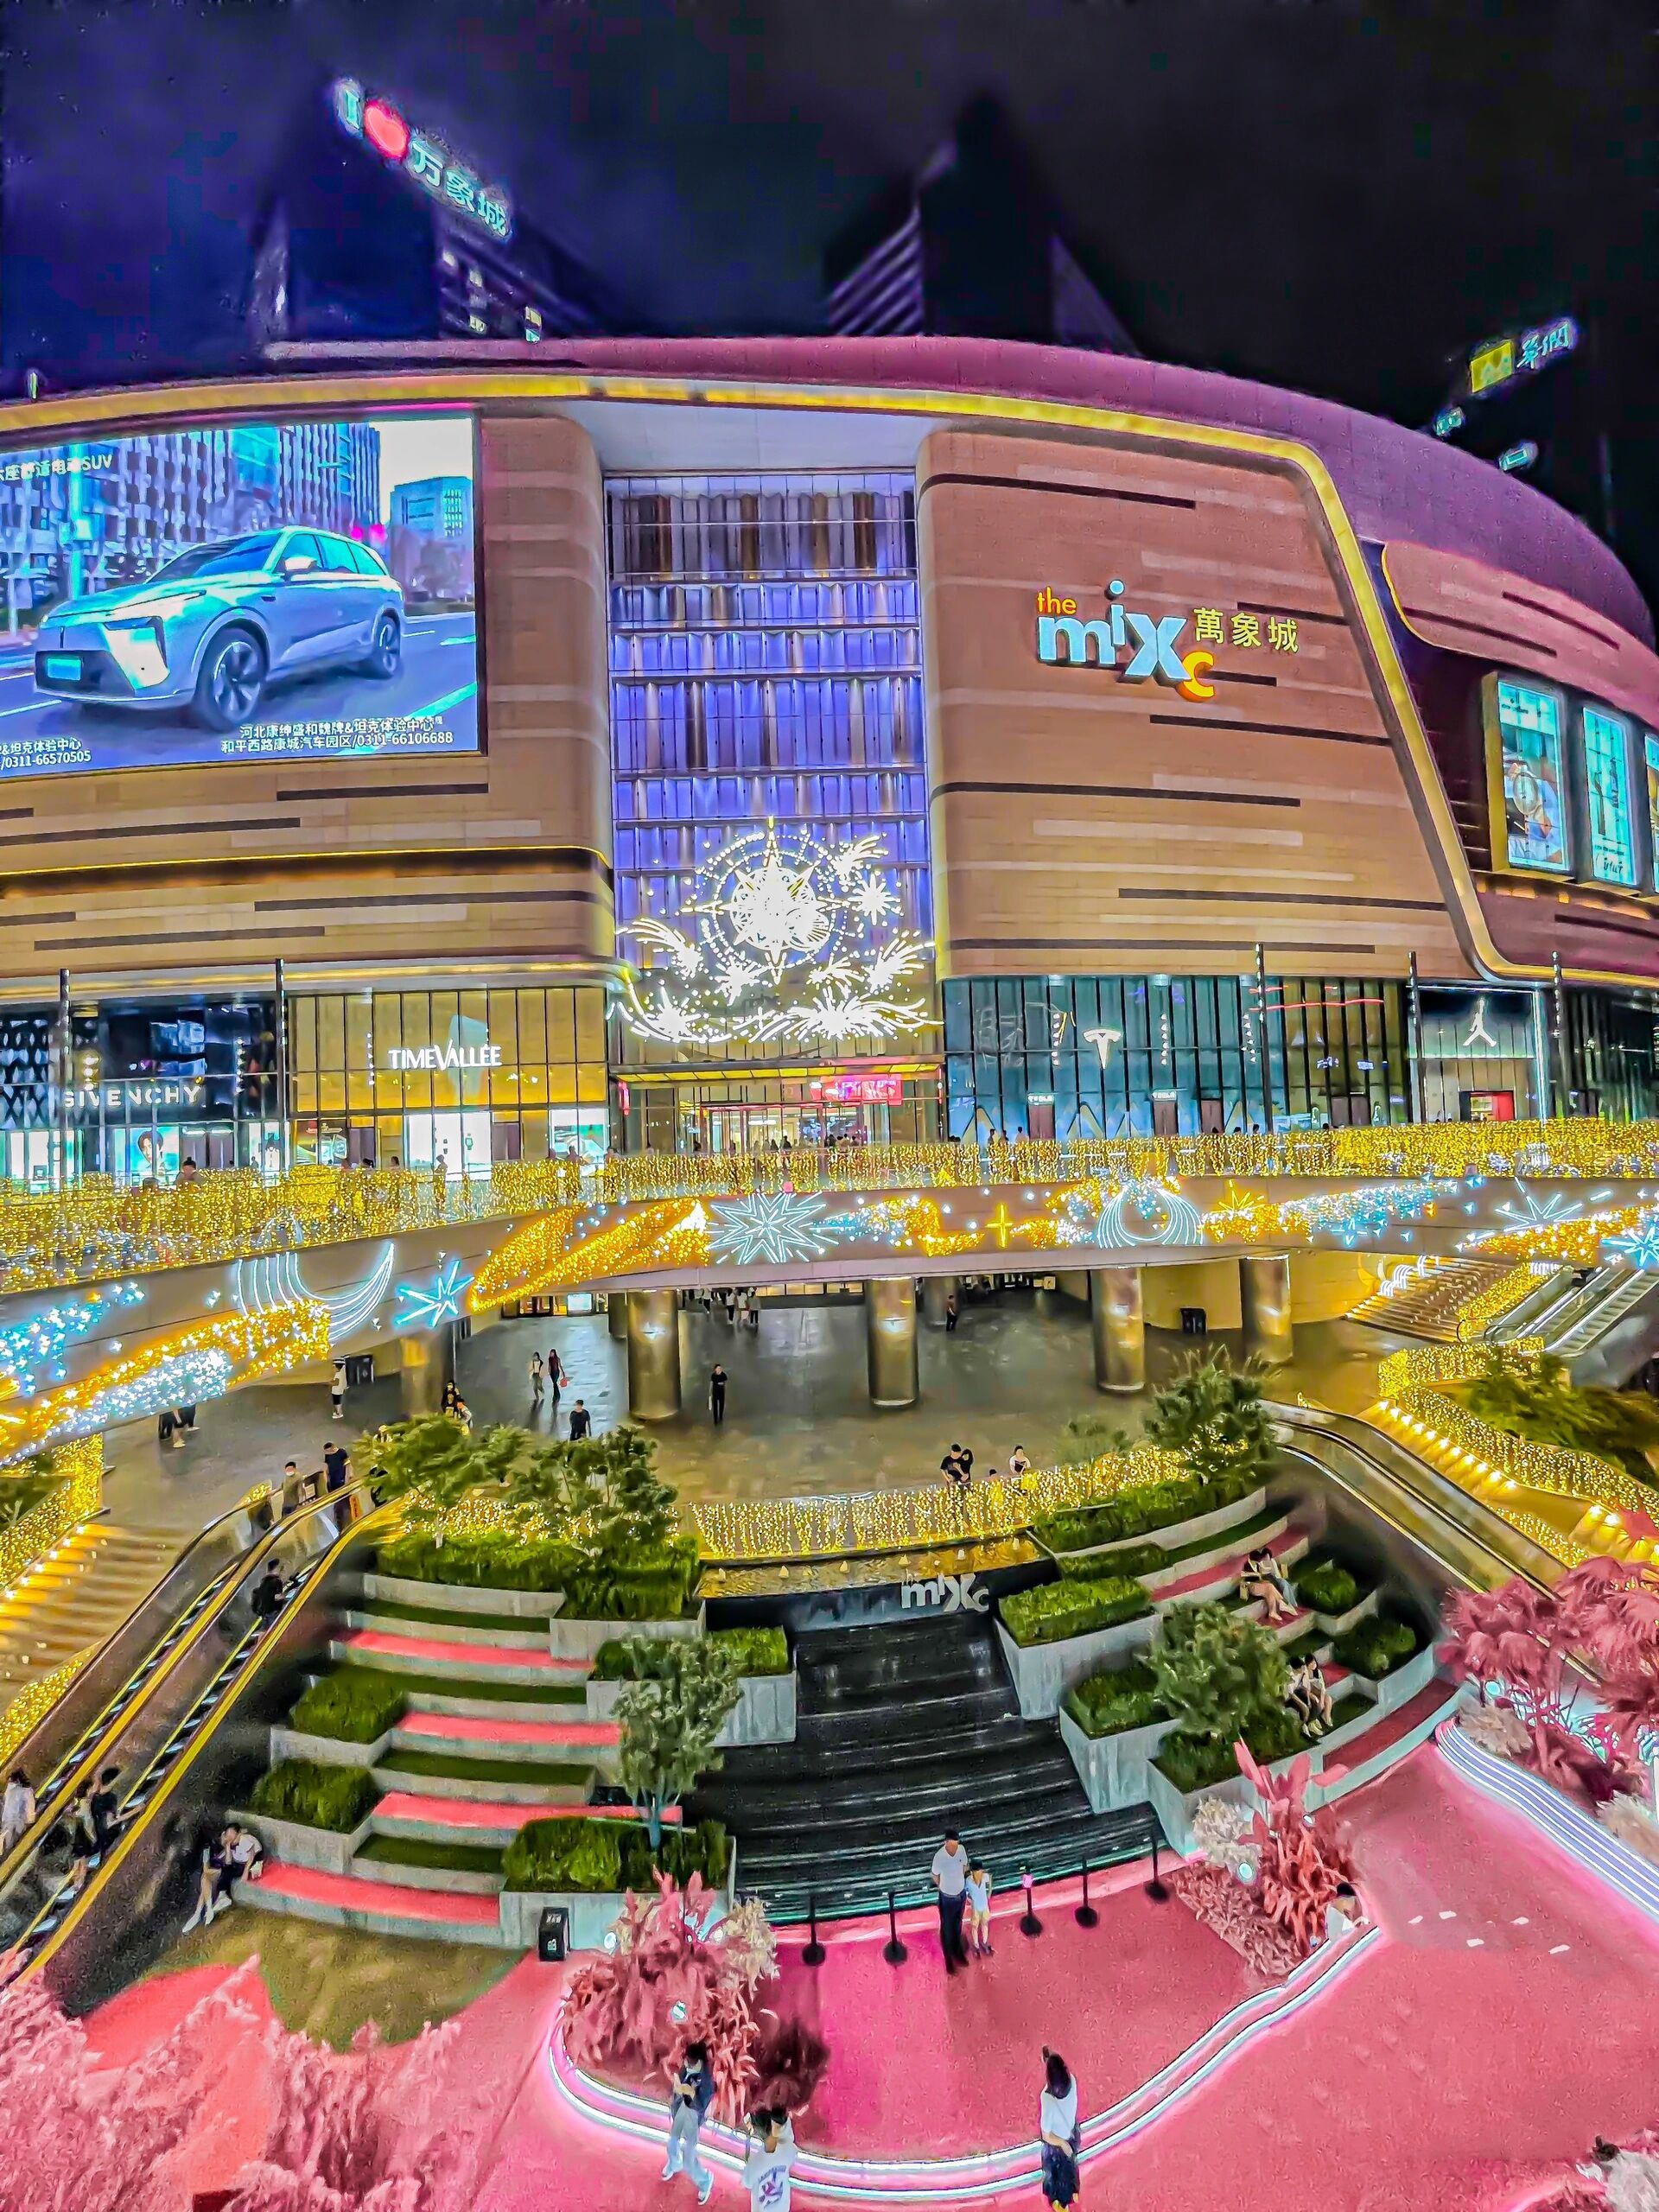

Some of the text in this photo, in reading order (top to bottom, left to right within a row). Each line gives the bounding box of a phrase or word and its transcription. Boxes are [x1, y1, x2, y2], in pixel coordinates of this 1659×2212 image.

[412, 142, 506, 237] 万象城
[1037, 586, 1077, 615] the
[1193, 607, 1299, 653] 萬象城
[0, 736, 82, 756] &坦克体验中心
